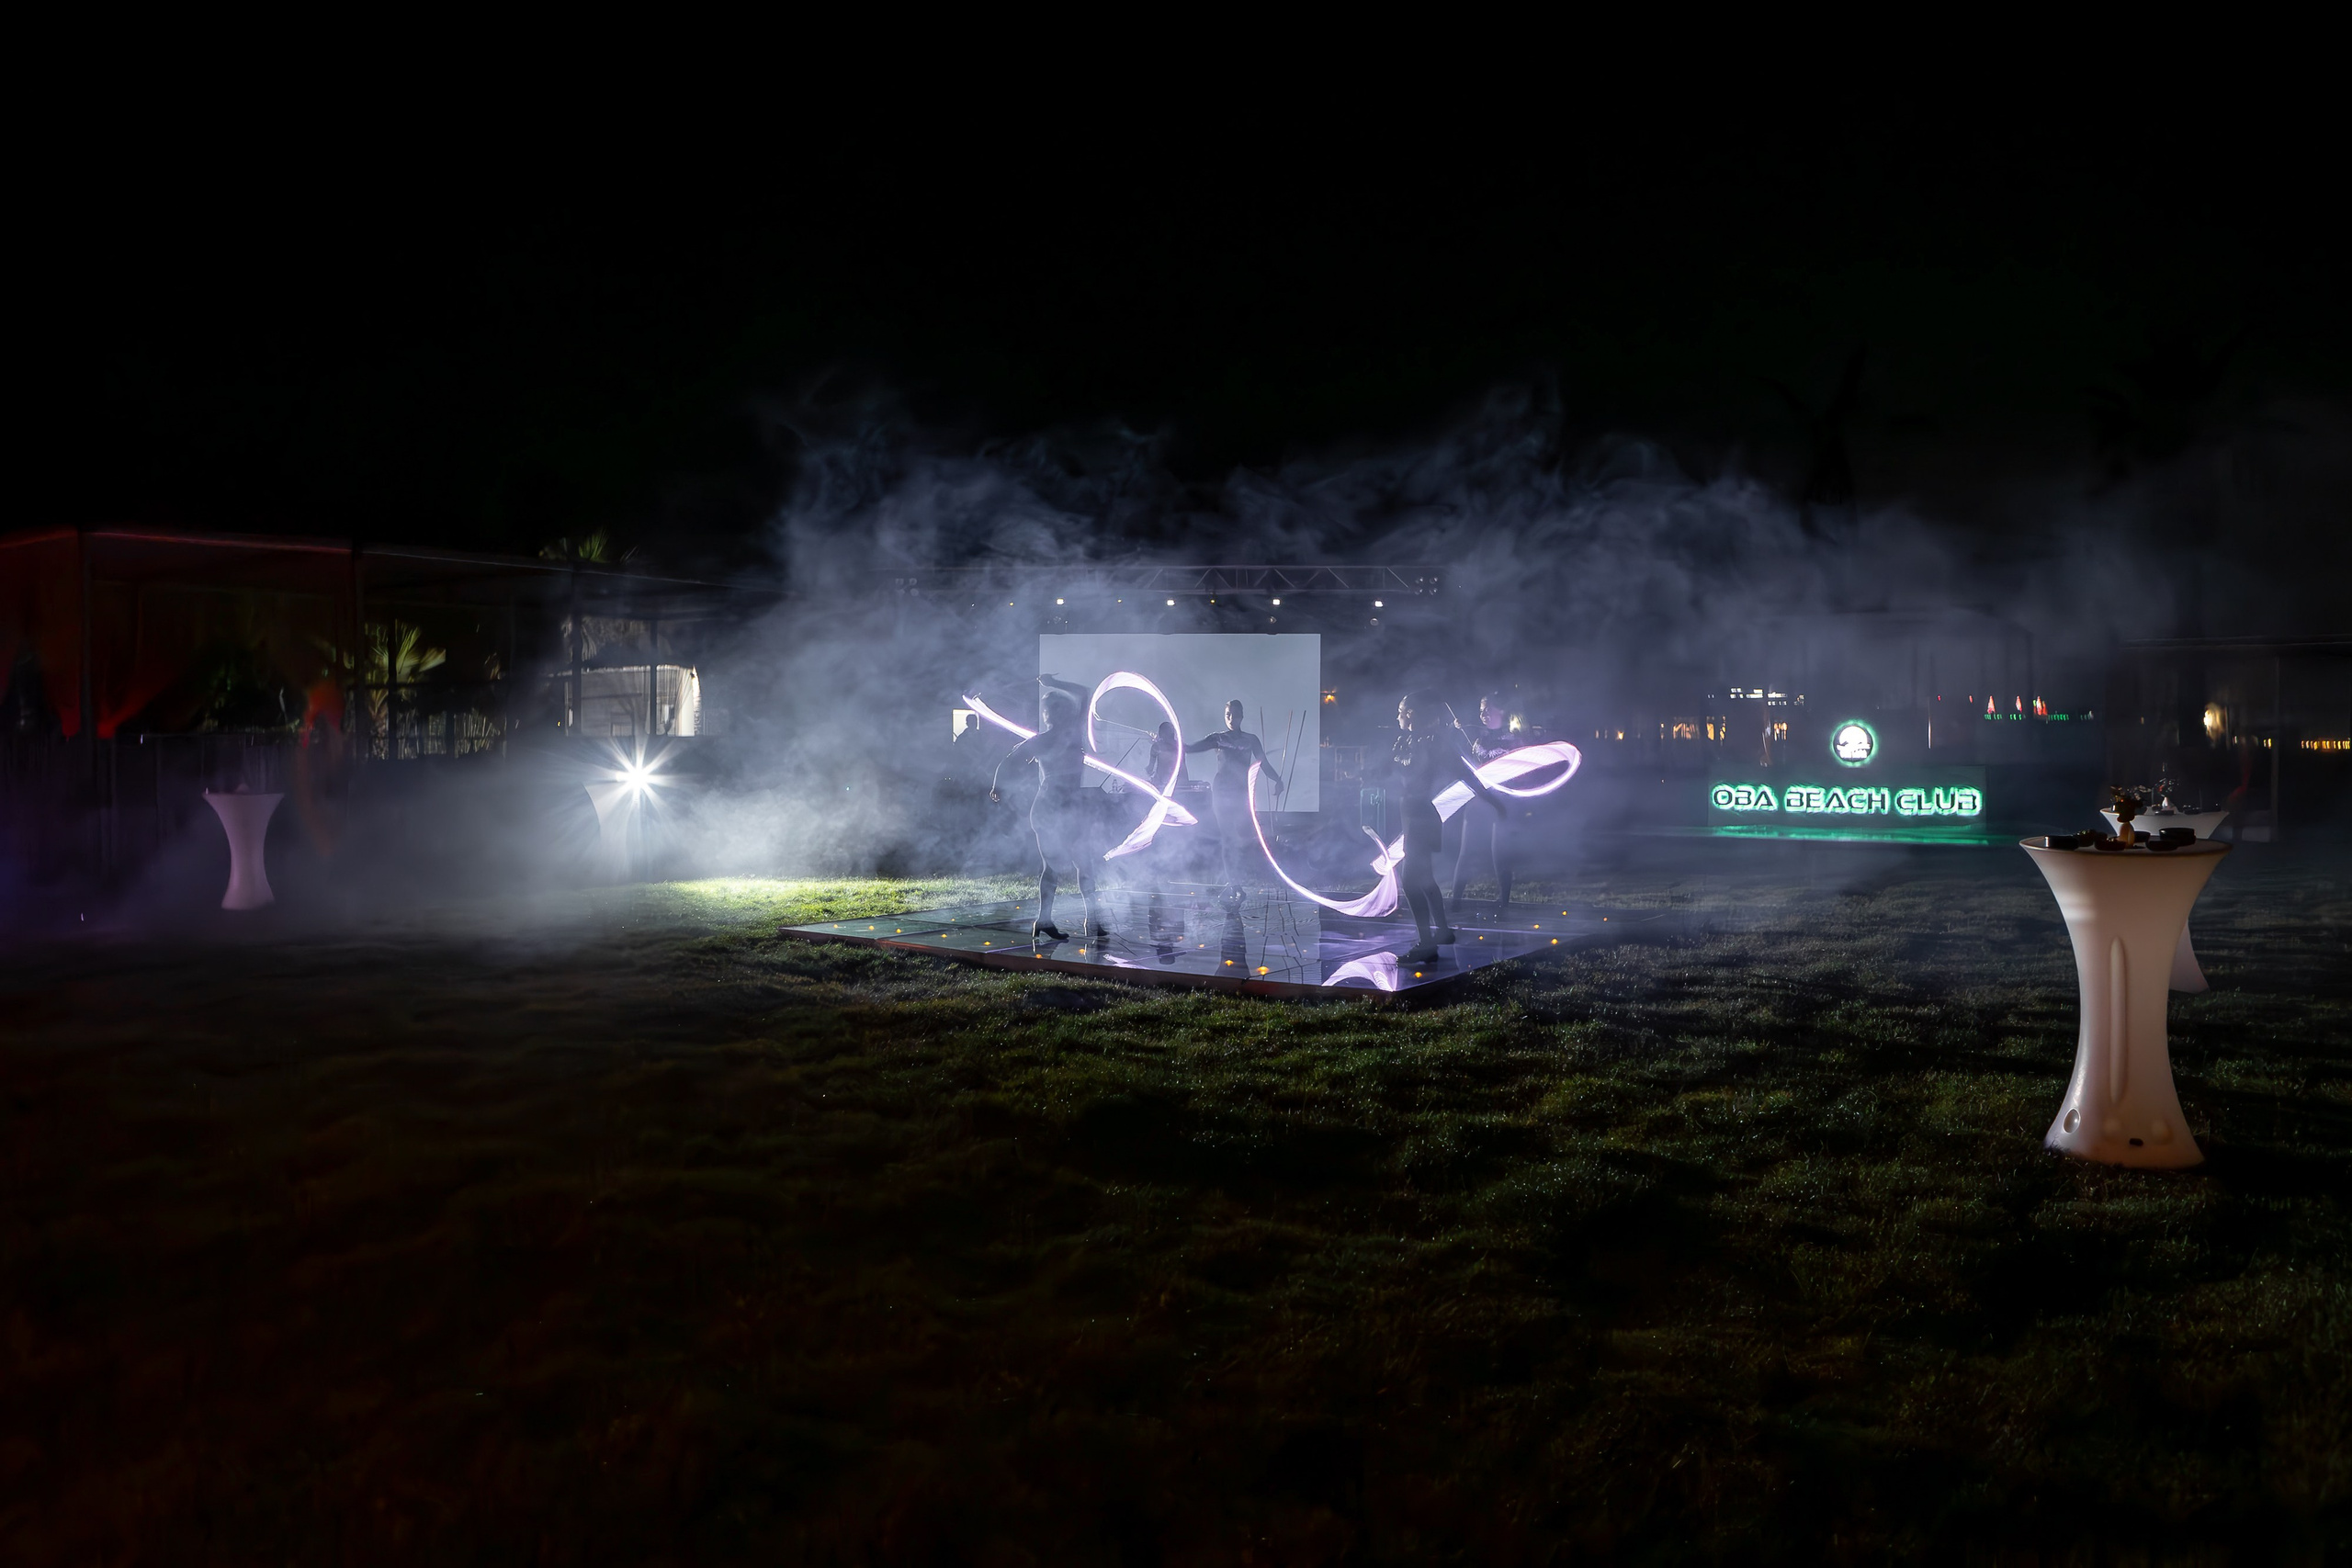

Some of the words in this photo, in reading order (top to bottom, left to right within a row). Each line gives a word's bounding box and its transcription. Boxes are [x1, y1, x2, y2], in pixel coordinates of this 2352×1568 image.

[1713, 784, 1777, 811] OBA
[1785, 786, 1889, 814] BEACH
[1895, 788, 1982, 816] CLUB
